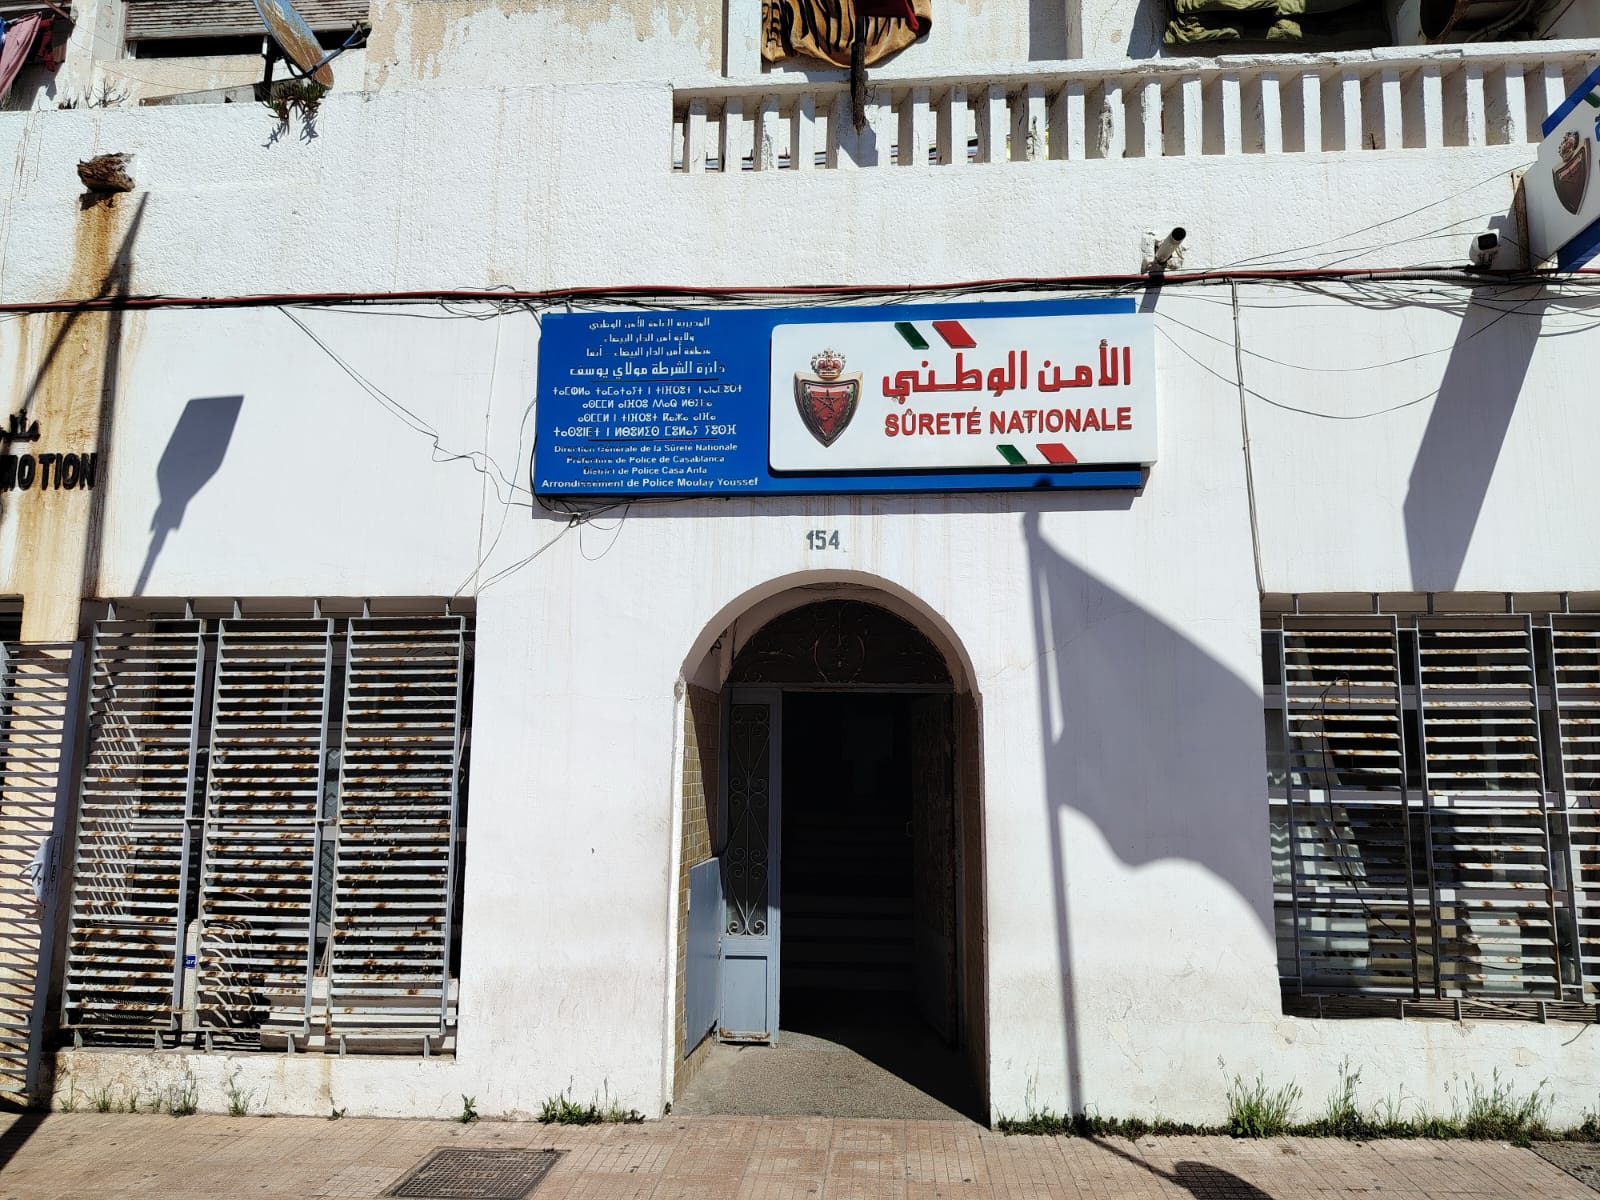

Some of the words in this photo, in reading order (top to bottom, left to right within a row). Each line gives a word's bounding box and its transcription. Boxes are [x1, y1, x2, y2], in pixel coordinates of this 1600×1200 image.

[589, 319, 621, 331] الوطني
[625, 315, 645, 329] للأمن
[636, 332, 654, 343] الدار
[656, 329, 672, 342] أمن
[646, 346, 664, 358] الدار
[666, 341, 682, 357] أمن
[569, 364, 609, 379] يوسف
[612, 361, 648, 379] مولاي
[651, 360, 693, 377] الشرطة
[696, 360, 726, 376] دائرة
[1037, 339, 1131, 393] الأمن
[882, 350, 1029, 405] الوطني
[884, 407, 983, 437] SÛRETÉ
[989, 406, 1133, 435] NATIONALE
[554, 445, 595, 453] Direction
[597, 444, 637, 453] Générale
[640, 444, 651, 453] de
[653, 444, 662, 452] la
[664, 443, 693, 452] Sûreté
[695, 443, 738, 451] Nationale
[566, 455, 613, 464] Préfecture
[615, 456, 627, 464] de
[629, 456, 657, 464] Police
[673, 455, 725, 463] Casablanca
[583, 467, 615, 475] District
[618, 467, 629, 475] de
[632, 467, 659, 475] Police
[662, 466, 684, 474] Casa
[686, 466, 707, 474] Anfa
[541, 479, 624, 488] Arrondissement
[627, 479, 640, 487] de
[642, 478, 674, 487] Police
[677, 478, 714, 489] Moulay
[718, 477, 758, 486] Youssef
[806, 529, 840, 551] 154
